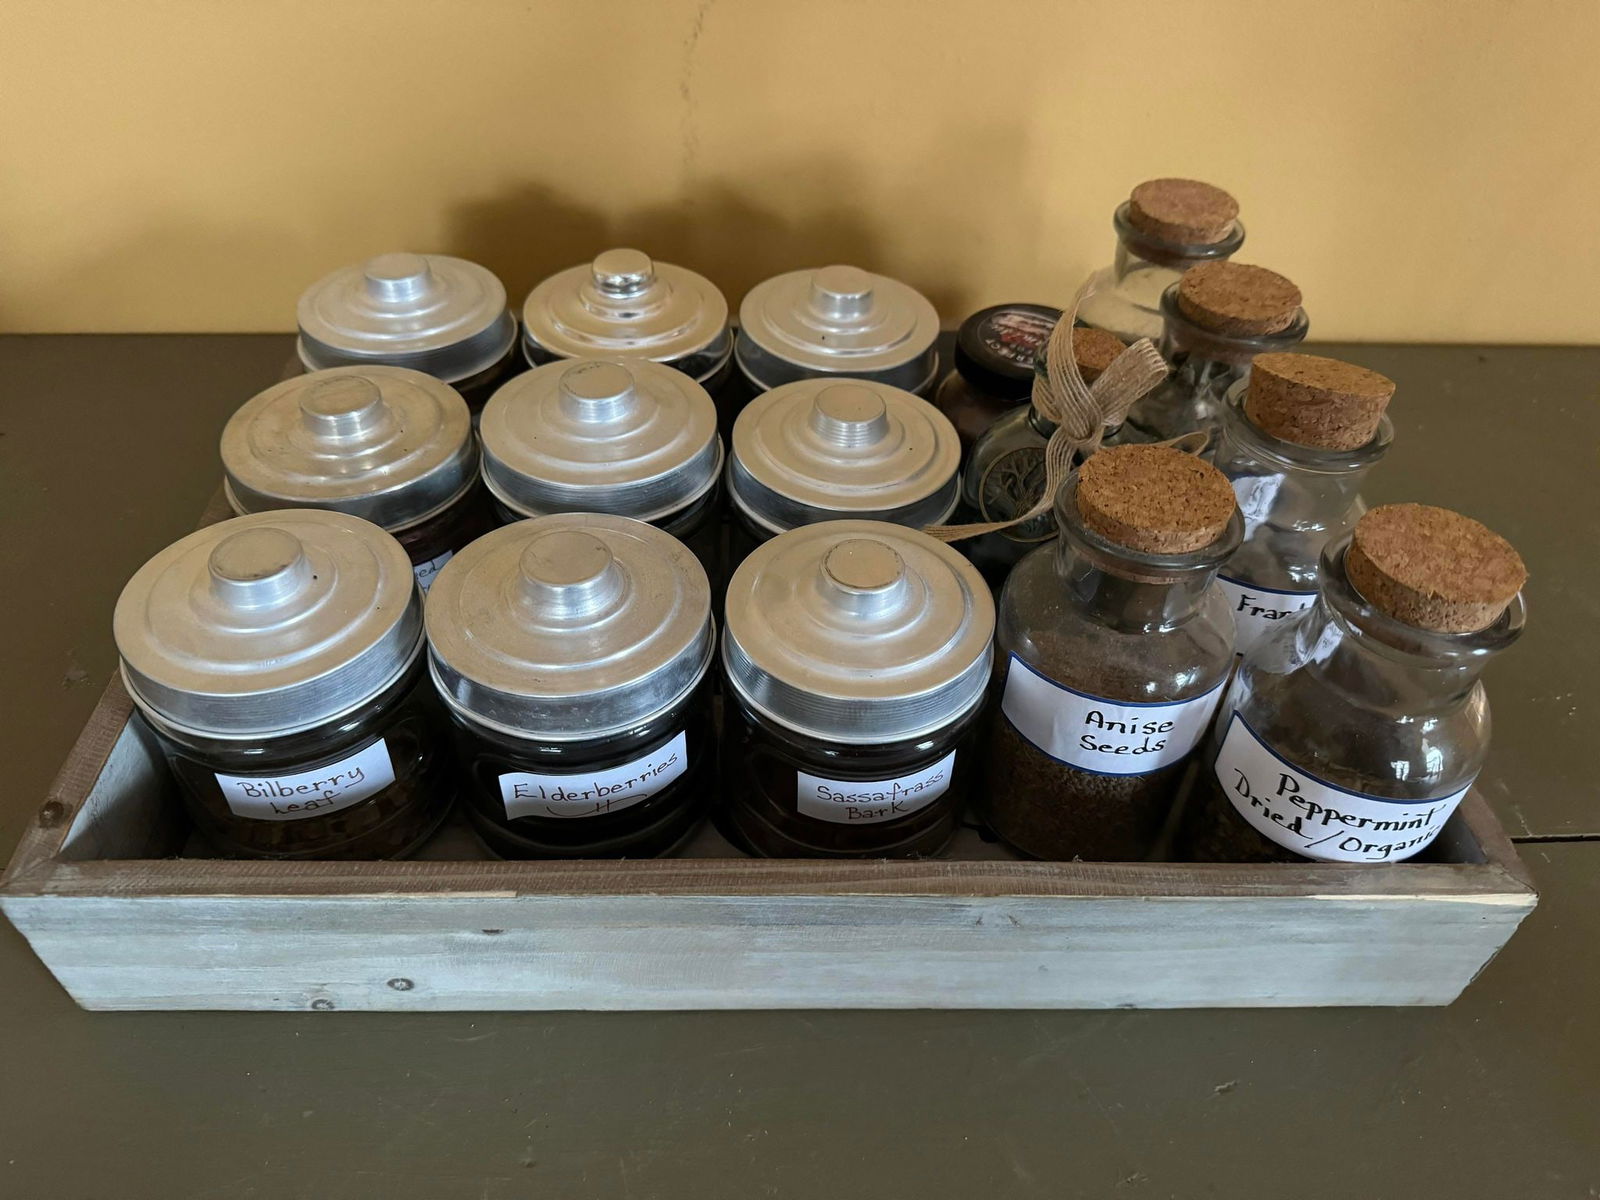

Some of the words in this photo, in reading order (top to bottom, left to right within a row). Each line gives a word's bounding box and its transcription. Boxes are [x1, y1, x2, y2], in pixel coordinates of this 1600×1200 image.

[1085, 710, 1175, 735] Anise
[1079, 734, 1167, 755] Seeds
[237, 766, 366, 798] Bilberry
[513, 753, 678, 802] Elderberries
[816, 769, 945, 804] Sassafrass
[270, 790, 342, 815] Leaf
[1275, 772, 1447, 832] Peppermint
